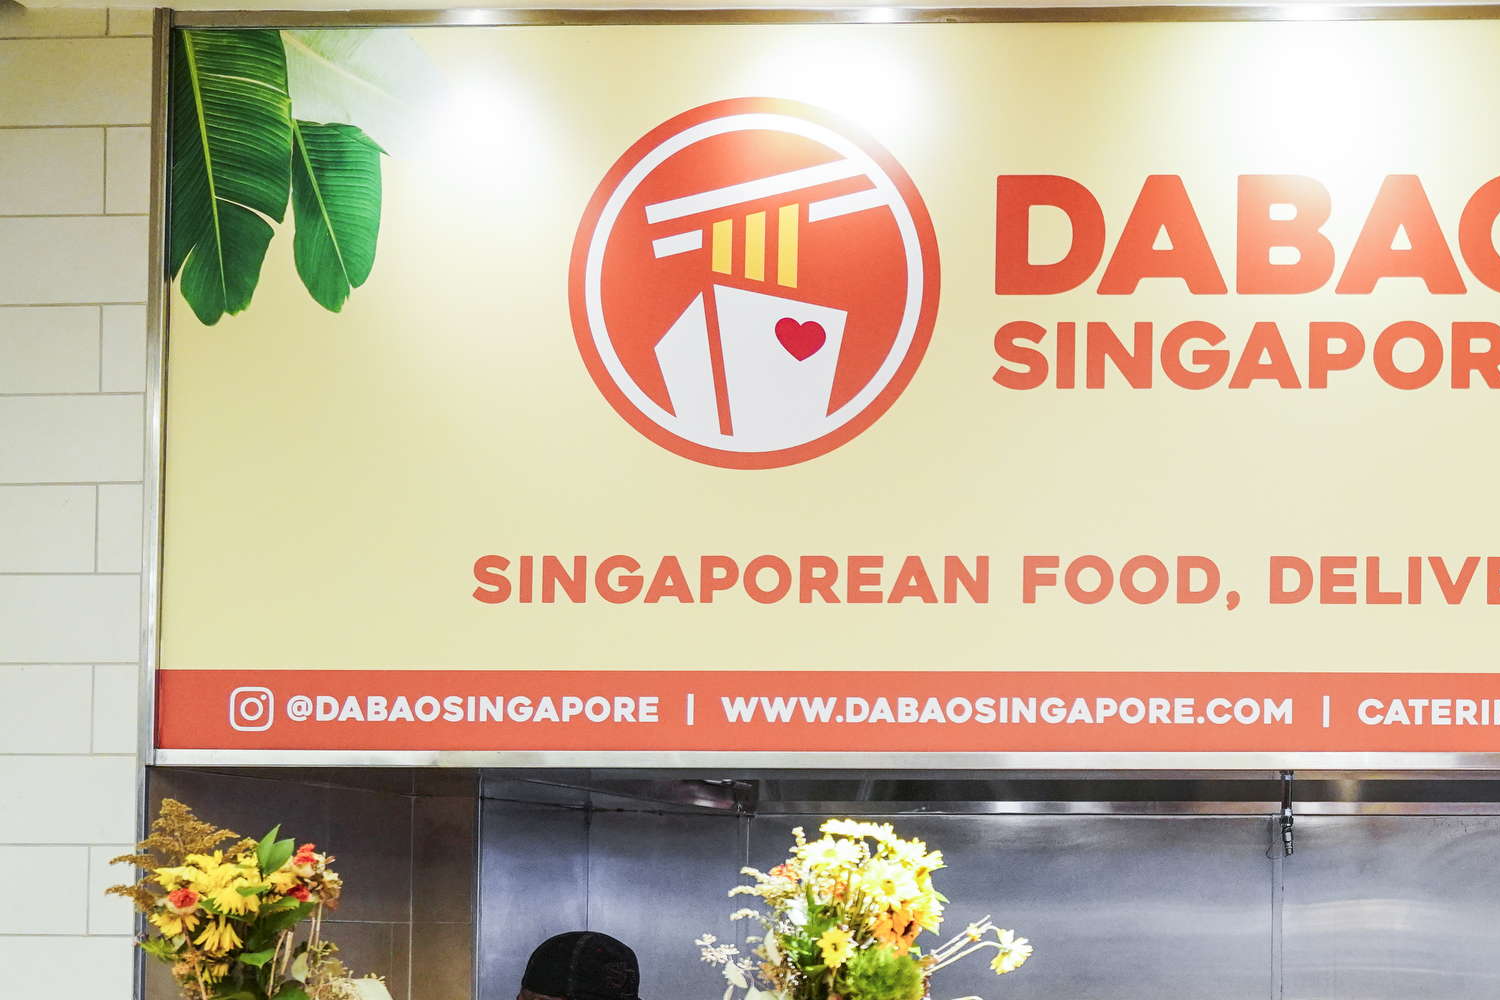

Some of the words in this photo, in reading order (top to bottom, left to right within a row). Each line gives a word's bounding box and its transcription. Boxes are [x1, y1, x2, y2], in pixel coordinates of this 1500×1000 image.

[472, 555, 989, 604] SINGAPOREAN
[1023, 555, 1240, 611] FOOD,
[287, 695, 658, 722] @DABAOSINGAPORE
[721, 697, 1292, 724] WWW.DABAOSINGAPORE.COM
